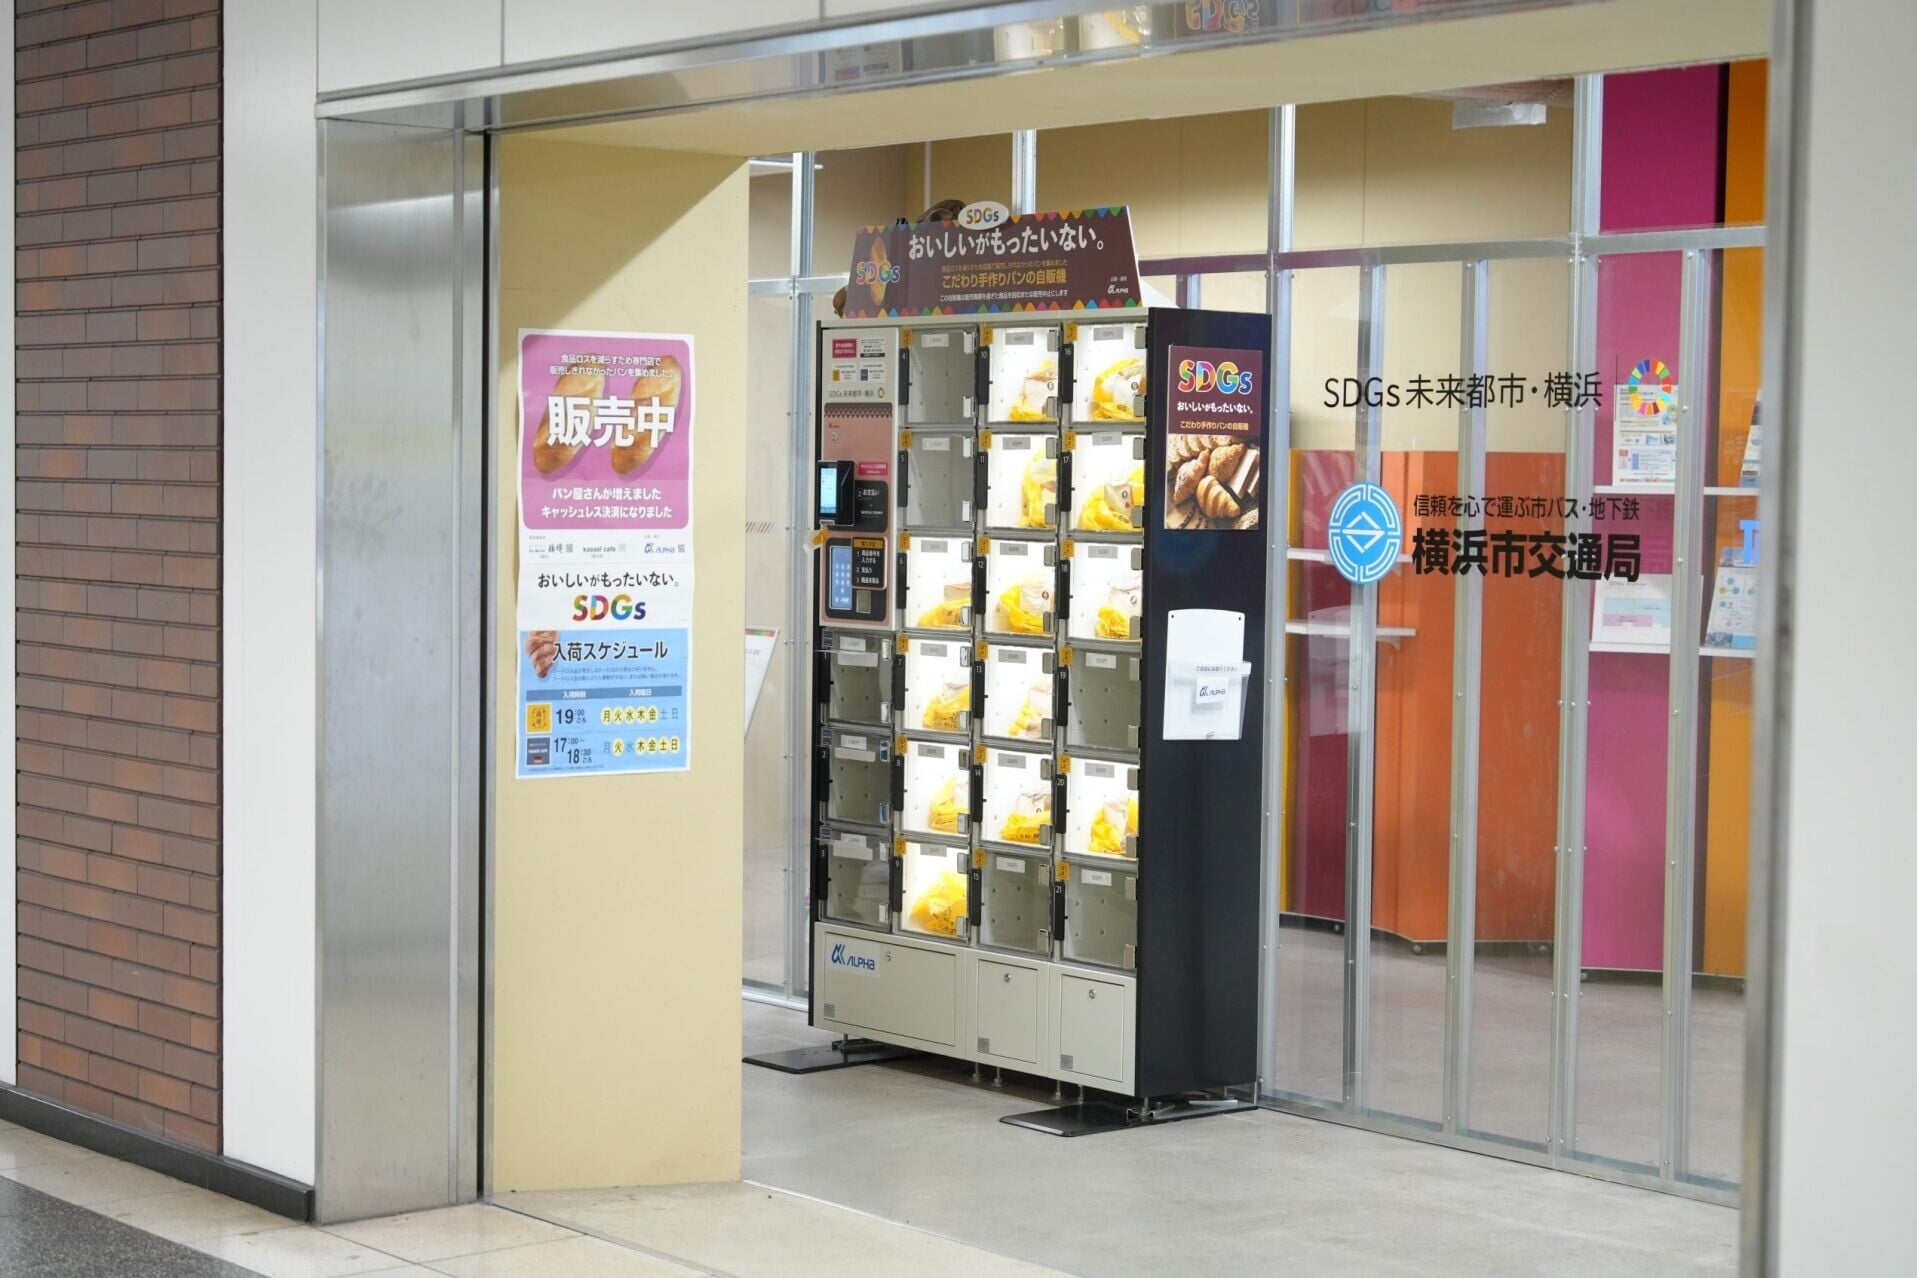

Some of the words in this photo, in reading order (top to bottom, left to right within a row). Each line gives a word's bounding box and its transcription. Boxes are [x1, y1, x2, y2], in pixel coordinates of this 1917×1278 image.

[966, 208, 999, 224] SDGs
[909, 223, 1103, 260] おいしいがもったいない。
[856, 261, 900, 285] SDGs
[942, 268, 1067, 289] こだわり手作りパンの自販機
[981, 351, 987, 359] 10
[1178, 359, 1253, 395] SDGs
[1323, 371, 1603, 409] SDGs未来都市・横浜
[1177, 401, 1254, 414] おいしいがもったいない。
[547, 395, 676, 448] 販売中
[1180, 420, 1249, 431] こだわり手作りパンの自販機
[980, 455, 985, 463] 11
[553, 488, 661, 500] パン屋さんが増えました
[541, 505, 672, 519] キャッシュレス決済になりました
[1413, 494, 1640, 521] 信頼を心で運ぶ市バス・地下鉄
[1412, 527, 1641, 583] 横浜市交通局
[538, 571, 679, 589] おいしいがもったいない。
[572, 594, 646, 621] SDGs
[552, 640, 668, 662] 入荷スケジュール
[976, 665, 982, 673] 13
[1057, 778, 1064, 786] 20
[973, 872, 979, 880] 15
